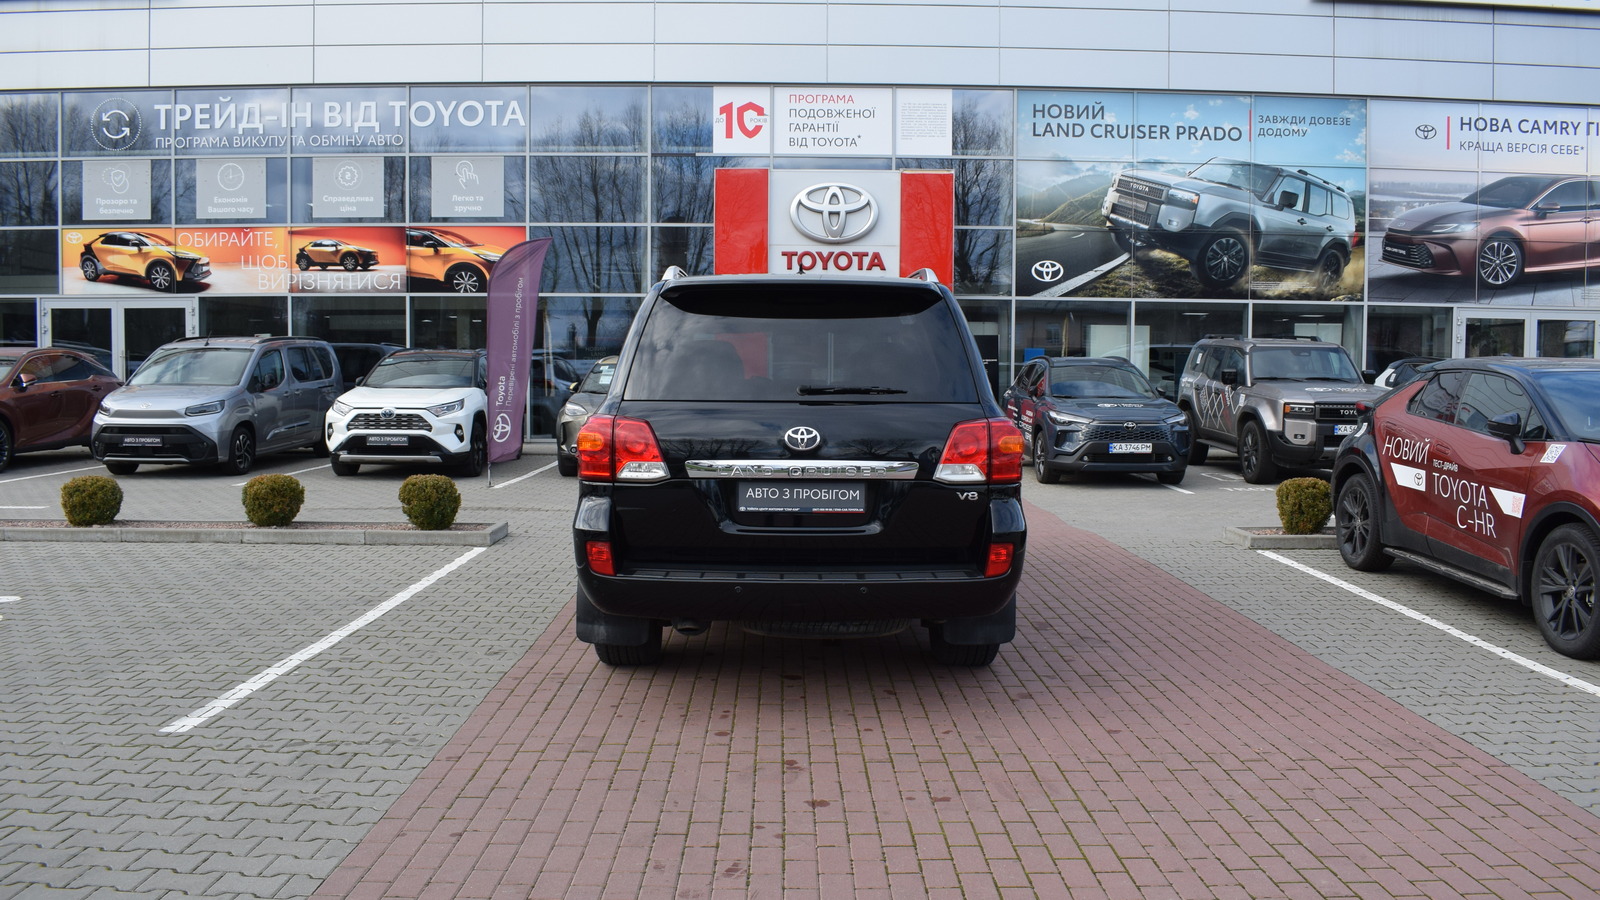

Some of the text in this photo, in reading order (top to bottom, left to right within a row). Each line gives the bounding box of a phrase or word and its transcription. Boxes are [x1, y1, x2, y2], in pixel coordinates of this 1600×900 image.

[788, 94, 855, 104] ПРОГРАМА
[154, 96, 526, 135] ТРЕЙД-ІН ВІД TOYOTA
[788, 107, 877, 120] ПОДОВЖЕНОЇ
[1032, 101, 1105, 120] НОВИЙ
[1257, 114, 1351, 126] ЗАВЖДИ ДОВЕЗЕ
[1460, 116, 1512, 133] НОВА
[1518, 118, 1581, 136] CAMRY
[788, 121, 840, 133] ГАРАНТІЇ
[1032, 122, 1243, 142] LAND CRUISER PRADO
[1257, 127, 1308, 138] ДОДОМУ
[155, 134, 404, 149] ПРОГРАМА ВИКУПУ ТА ОБМІНУ АВТО
[788, 137, 808, 148] ВІД
[1459, 140, 1504, 154] КРАЩА
[1507, 142, 1548, 154] ВЕРСІЯ
[1130, 182, 1149, 192] TOYOTA
[95, 197, 128, 206] Прозоро
[213, 196, 248, 204] Економія
[322, 195, 374, 203] Справедлива
[451, 194, 474, 202] Легко
[99, 206, 134, 215] безпечно
[207, 205, 236, 213] Вашого
[339, 205, 357, 213] ціна
[454, 205, 482, 213] зручно
[177, 228, 279, 249] ОБИРАЙТЕ,
[240, 254, 288, 271] ЩОБ
[781, 250, 887, 272] TOYOTA
[258, 273, 401, 291] ВИРІЗНЯТИСЯ
[515, 277, 524, 314] пробігом
[511, 320, 521, 362] автомобілі
[496, 375, 506, 406] Toyota
[506, 363, 516, 406] Перевірені
[1338, 425, 1348, 433] KA
[1113, 442, 1151, 451] KA 3746 PM
[1382, 435, 1431, 465] НОВИЙ
[716, 465, 887, 477] LAND CRUISER
[1432, 458, 1459, 473] ТЕСТ-ДРАЙВ
[745, 487, 780, 499] АВТО
[793, 488, 860, 501] ПРОБІГОМ
[955, 491, 979, 501] V8
[1432, 472, 1489, 510] TOYOTA
[1456, 505, 1497, 539] C-HR
